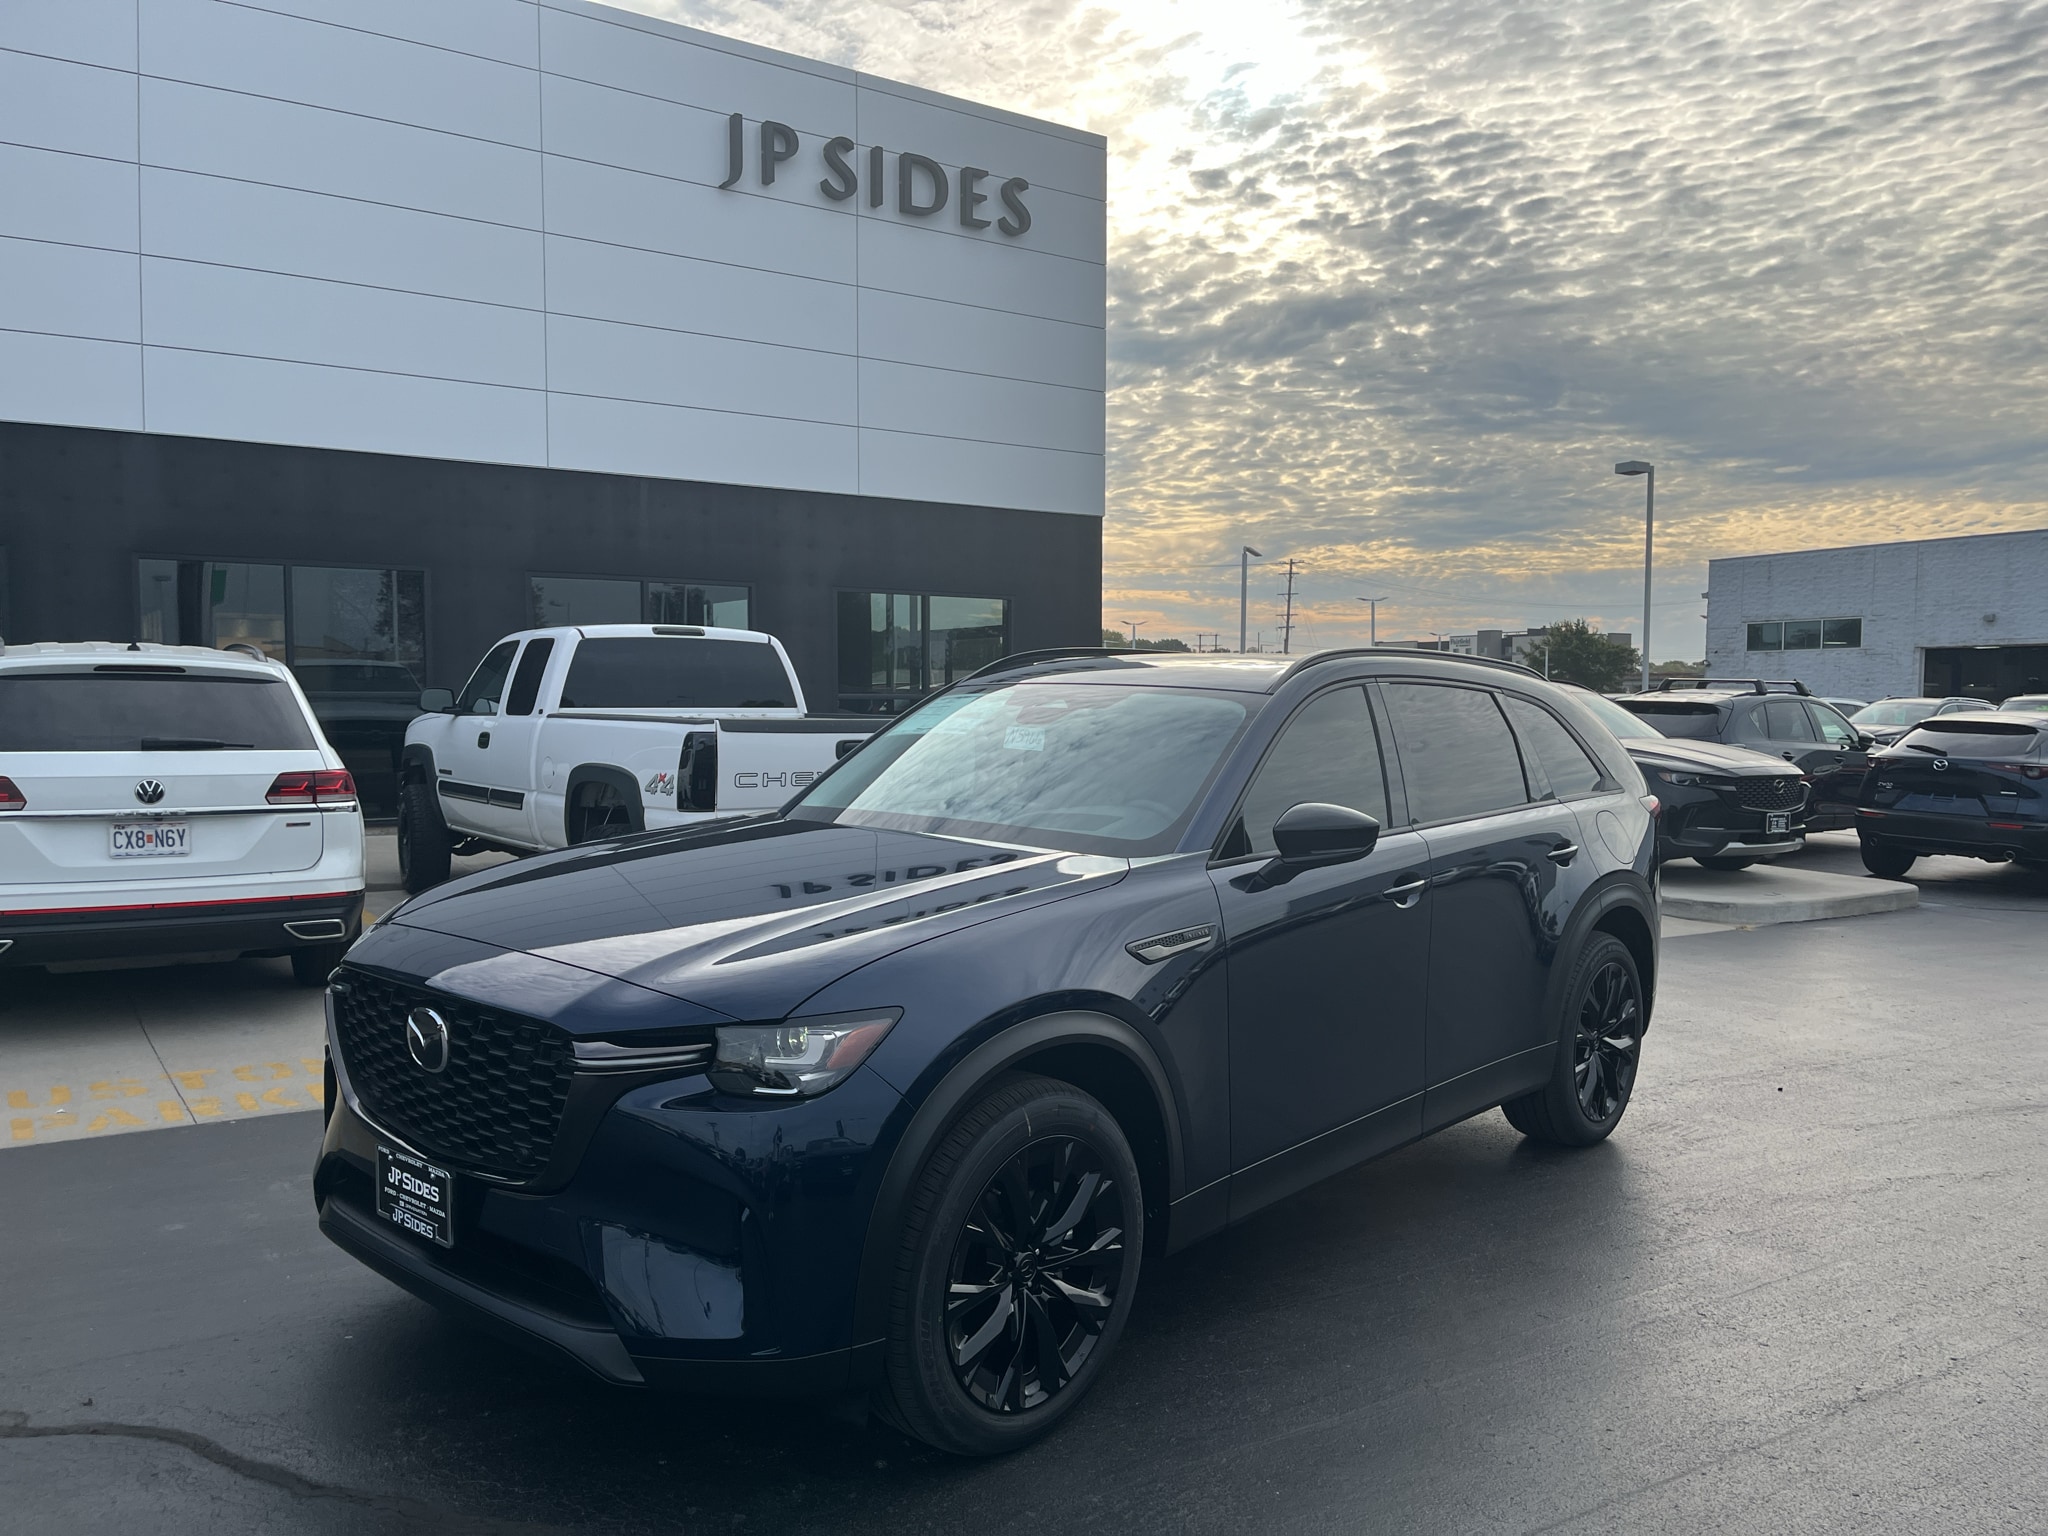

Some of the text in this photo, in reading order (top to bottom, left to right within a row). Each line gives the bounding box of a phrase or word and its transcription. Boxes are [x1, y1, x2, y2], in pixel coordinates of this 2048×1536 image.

[718, 112, 1032, 237] JP SIDES
[734, 771, 824, 789] CHE
[388, 1166, 440, 1203] JP SIDES
[392, 1208, 404, 1224] JP
[403, 1214, 434, 1239] SIDES
